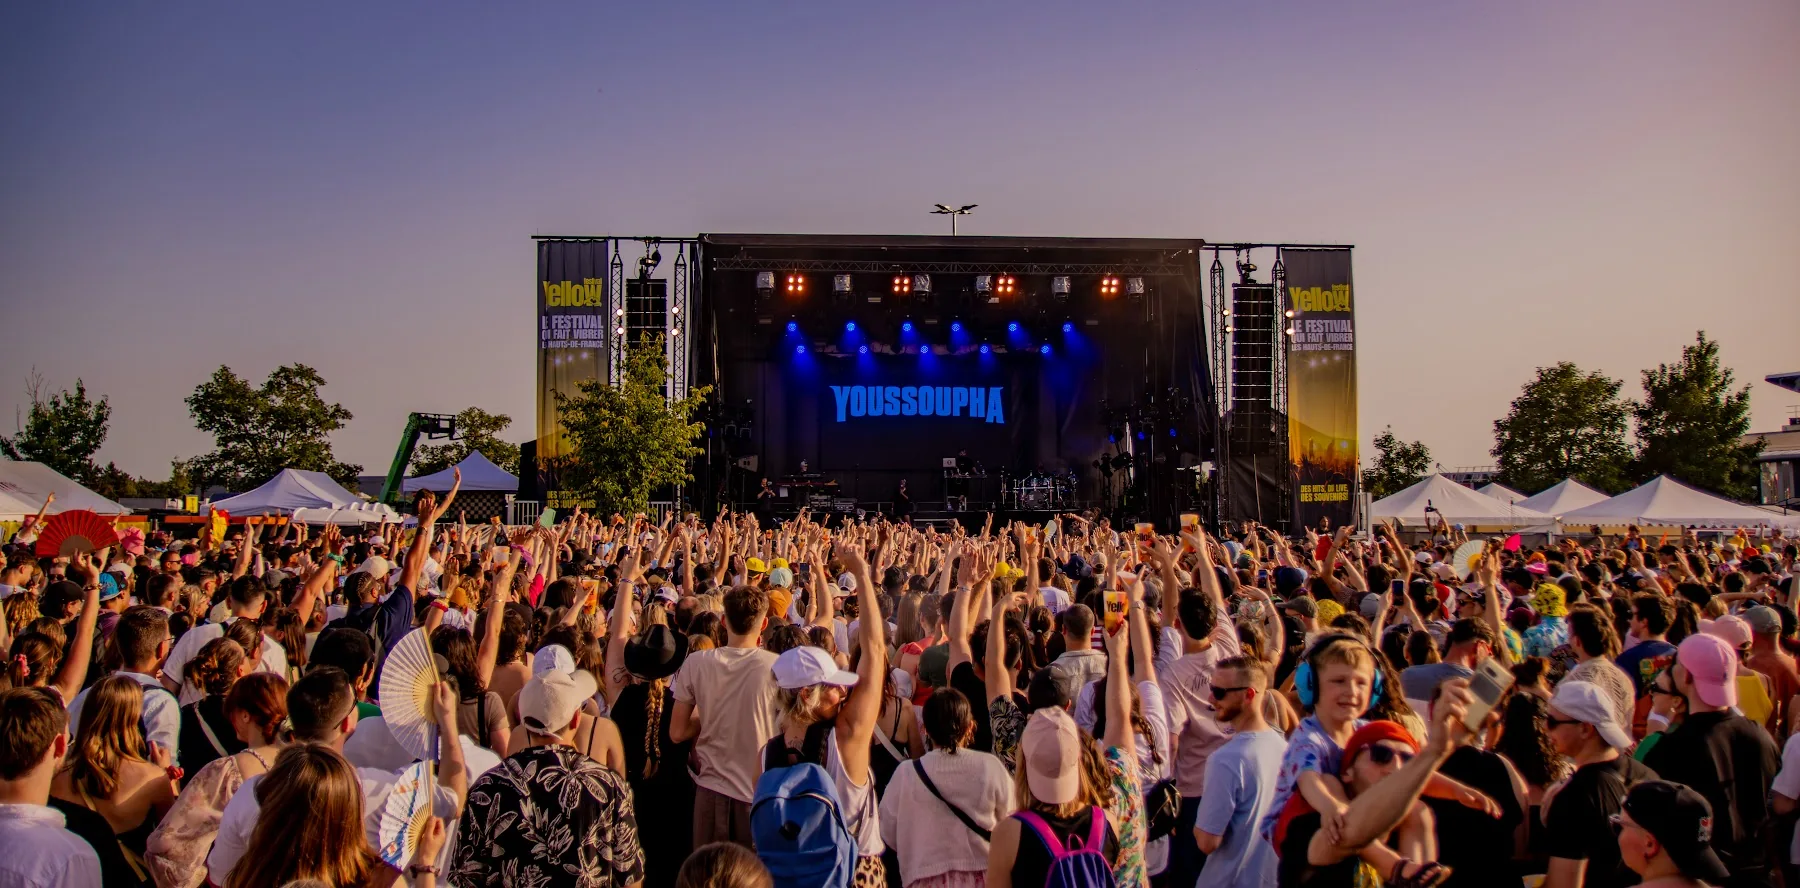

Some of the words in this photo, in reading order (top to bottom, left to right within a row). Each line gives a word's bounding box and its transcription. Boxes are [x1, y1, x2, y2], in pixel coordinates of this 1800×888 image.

[1289, 286, 1351, 312] Yellow
[552, 315, 604, 329] FESTIVAL
[1291, 320, 1302, 333] LE
[1306, 320, 1353, 332] FESTIVAL
[553, 329, 570, 339] FAIT
[573, 329, 604, 339] VIBRER
[1308, 333, 1323, 343] FAIT
[1326, 333, 1353, 342] VIBRER
[548, 340, 604, 348] HAUTS-DE-FRANCE
[1302, 343, 1353, 351] HAUTS-DE-FRANCE
[829, 385, 1004, 424] YOUSSOUPHA
[1300, 484, 1311, 493] DES
[1301, 492, 1313, 502] DES
